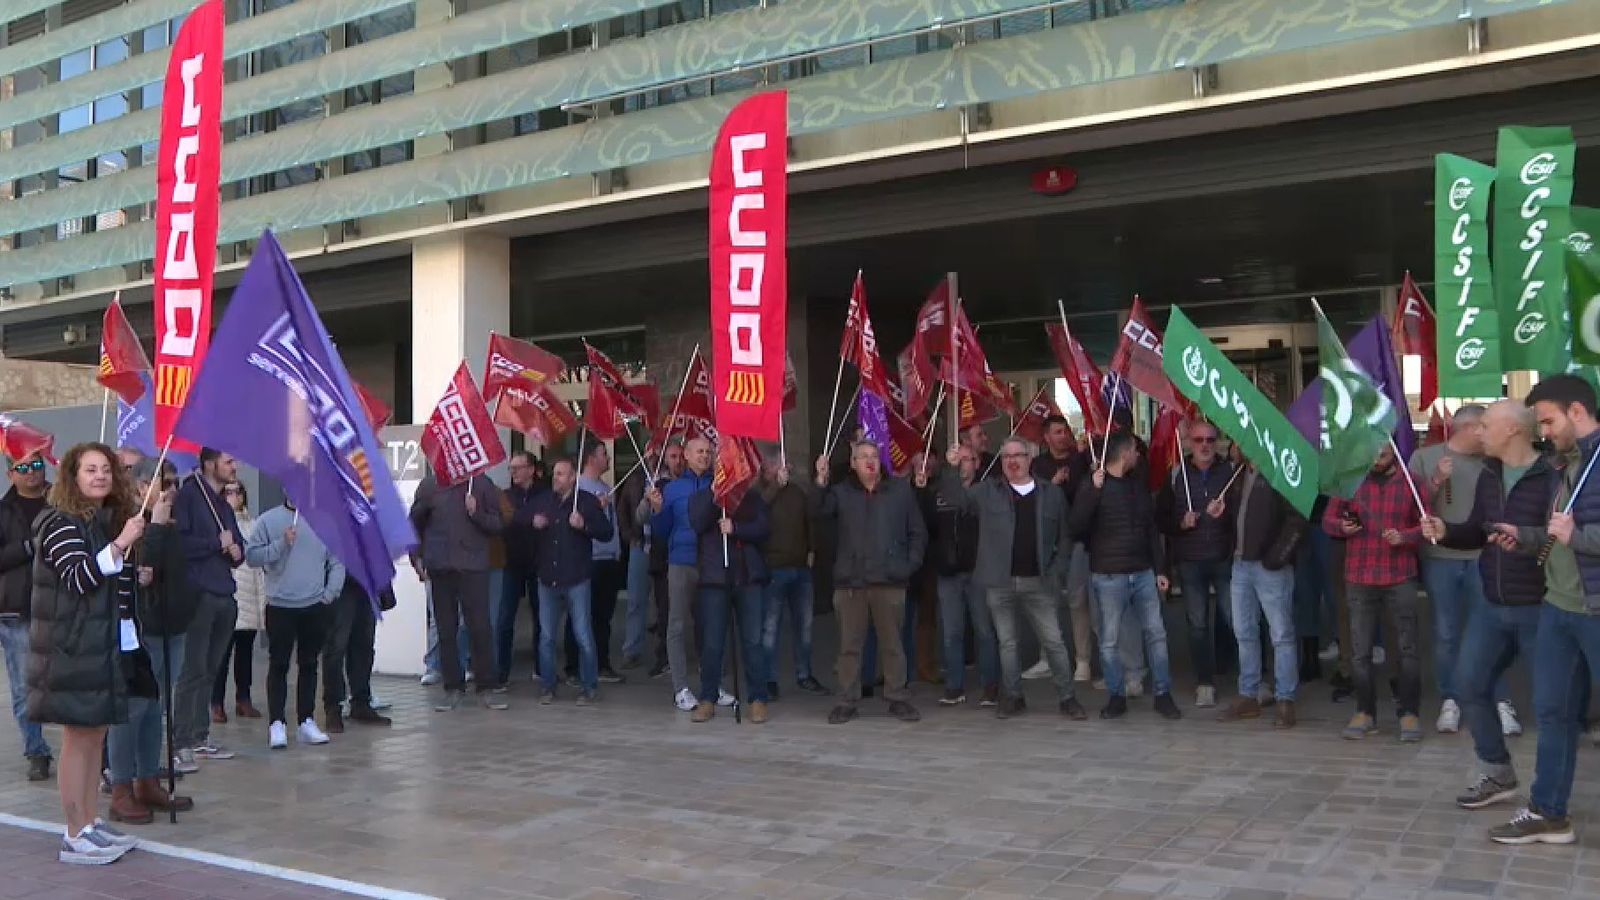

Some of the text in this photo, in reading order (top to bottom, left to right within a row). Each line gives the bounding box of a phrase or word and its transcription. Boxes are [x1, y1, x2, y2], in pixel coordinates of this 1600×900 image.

[160, 52, 205, 356] CCOO
[728, 132, 767, 367] CCOO
[1516, 186, 1551, 313] CSIF
[1451, 213, 1481, 338] CSIF
[387, 440, 420, 471] T2
[437, 392, 490, 473] CCOO
[1208, 367, 1280, 471] CSIF
